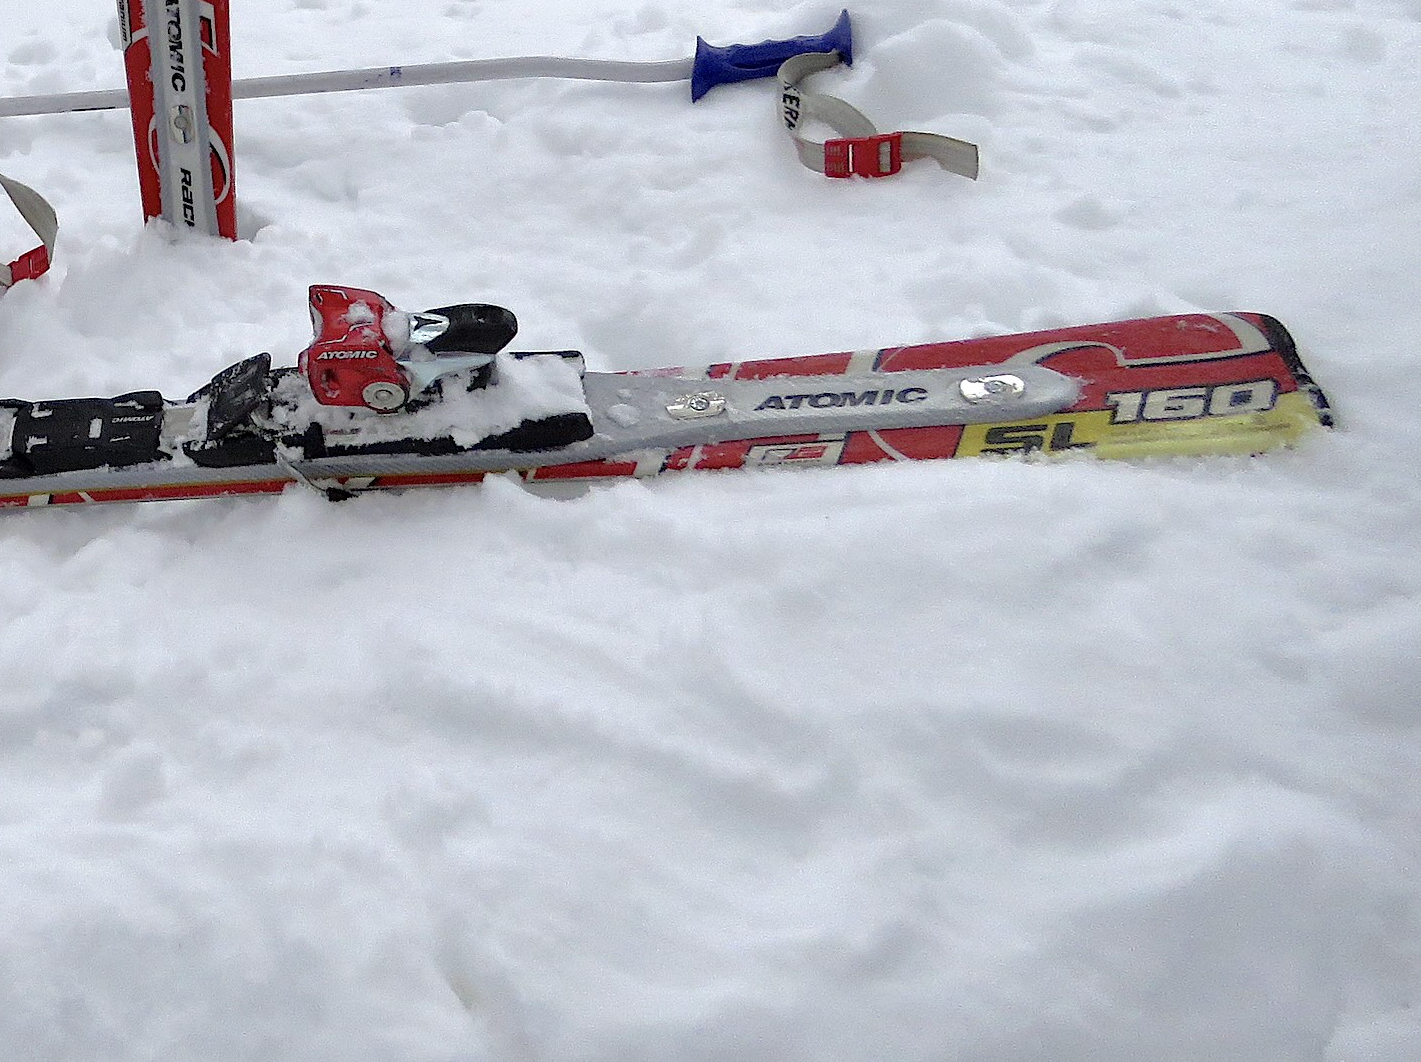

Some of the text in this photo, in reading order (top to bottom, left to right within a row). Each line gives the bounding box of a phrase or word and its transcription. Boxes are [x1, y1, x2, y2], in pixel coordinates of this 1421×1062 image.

[316, 349, 379, 361] ATOMIC
[753, 387, 930, 412] ATOMIC
[1106, 377, 1279, 425] 160
[111, 414, 155, 424] ATOMIC
[980, 421, 1098, 454] SL
